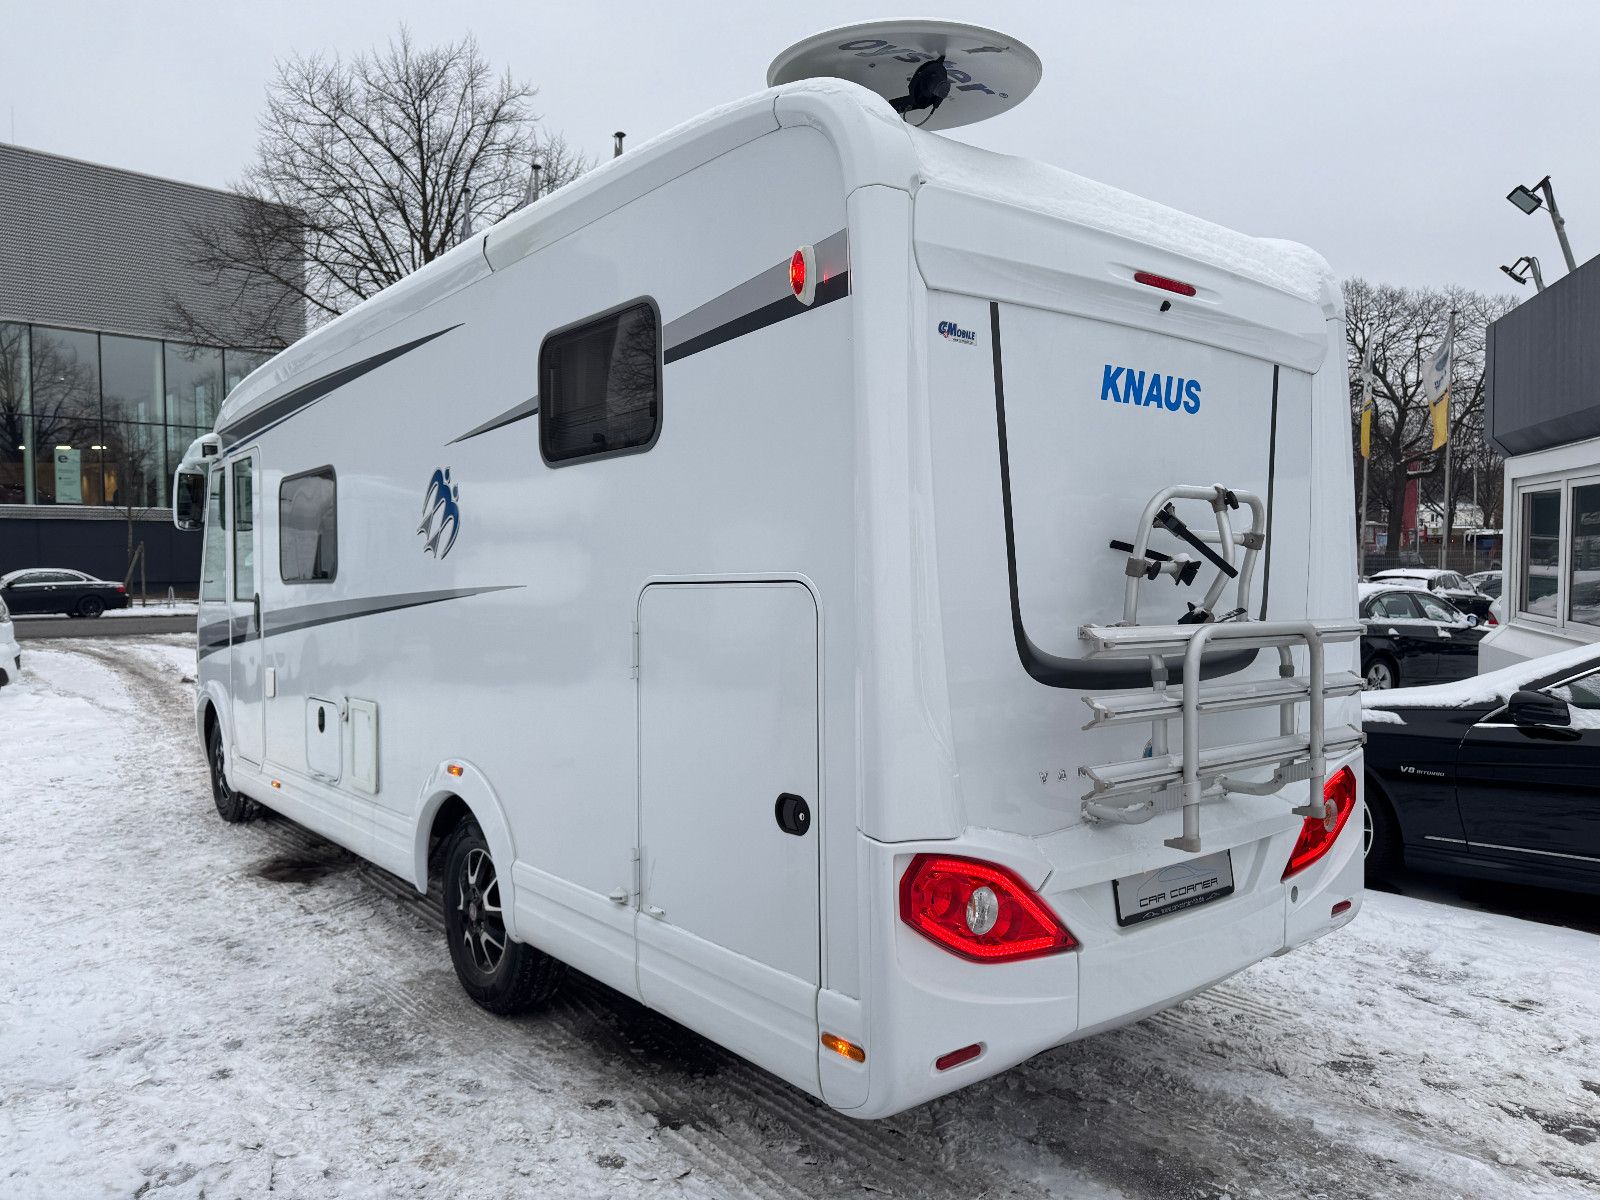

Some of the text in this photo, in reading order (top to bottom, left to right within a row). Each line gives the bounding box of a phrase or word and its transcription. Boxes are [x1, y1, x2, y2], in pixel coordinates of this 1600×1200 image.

[1101, 364, 1202, 415] KNAUS
[1400, 765, 1415, 774] V8
[1139, 892, 1166, 908] CAR
[1170, 877, 1218, 899] CORNER
